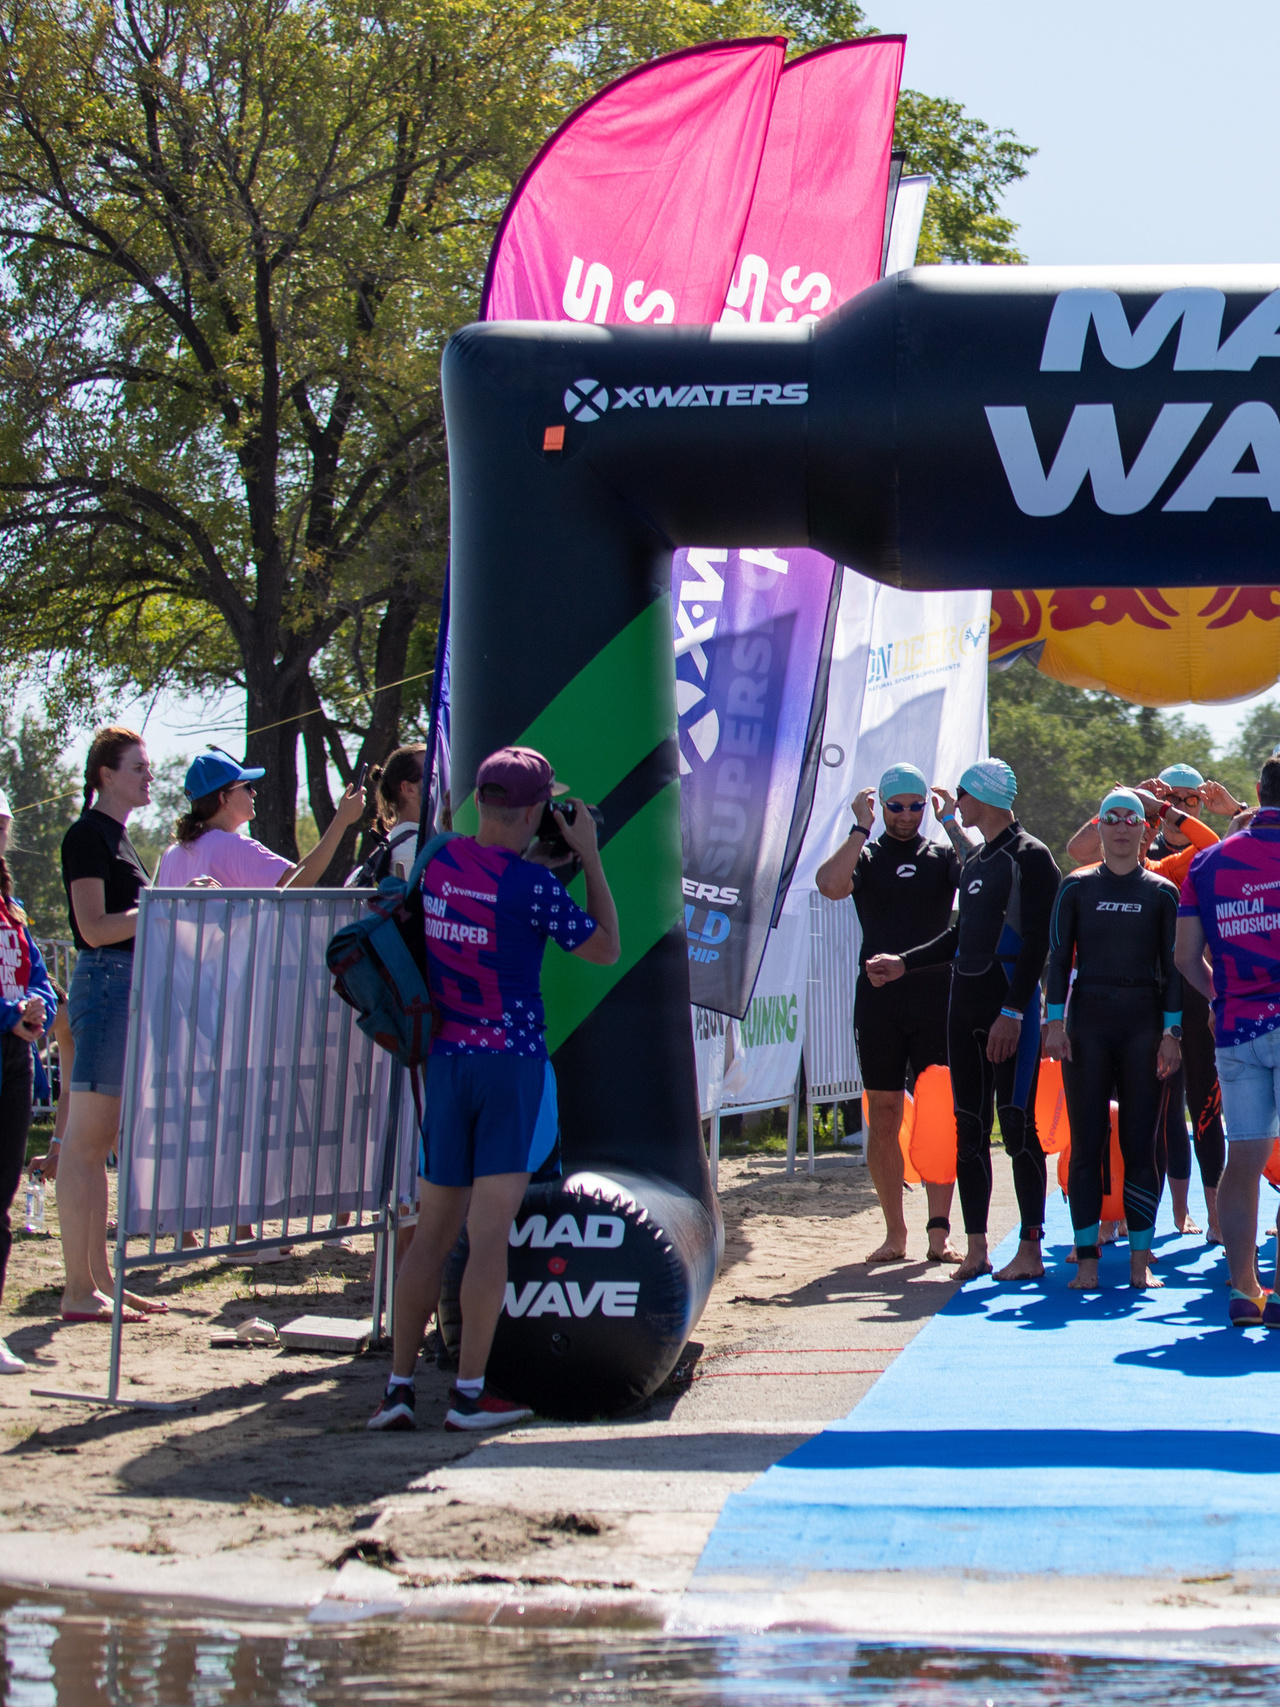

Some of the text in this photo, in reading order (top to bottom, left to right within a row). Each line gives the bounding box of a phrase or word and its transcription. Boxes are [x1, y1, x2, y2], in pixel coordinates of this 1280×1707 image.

[1216, 897, 1264, 920] NIKOLAI
[424, 917, 488, 944] ОЛОТАРЕВ
[508, 1213, 626, 1248] MAD
[500, 1281, 641, 1319] WAVE
